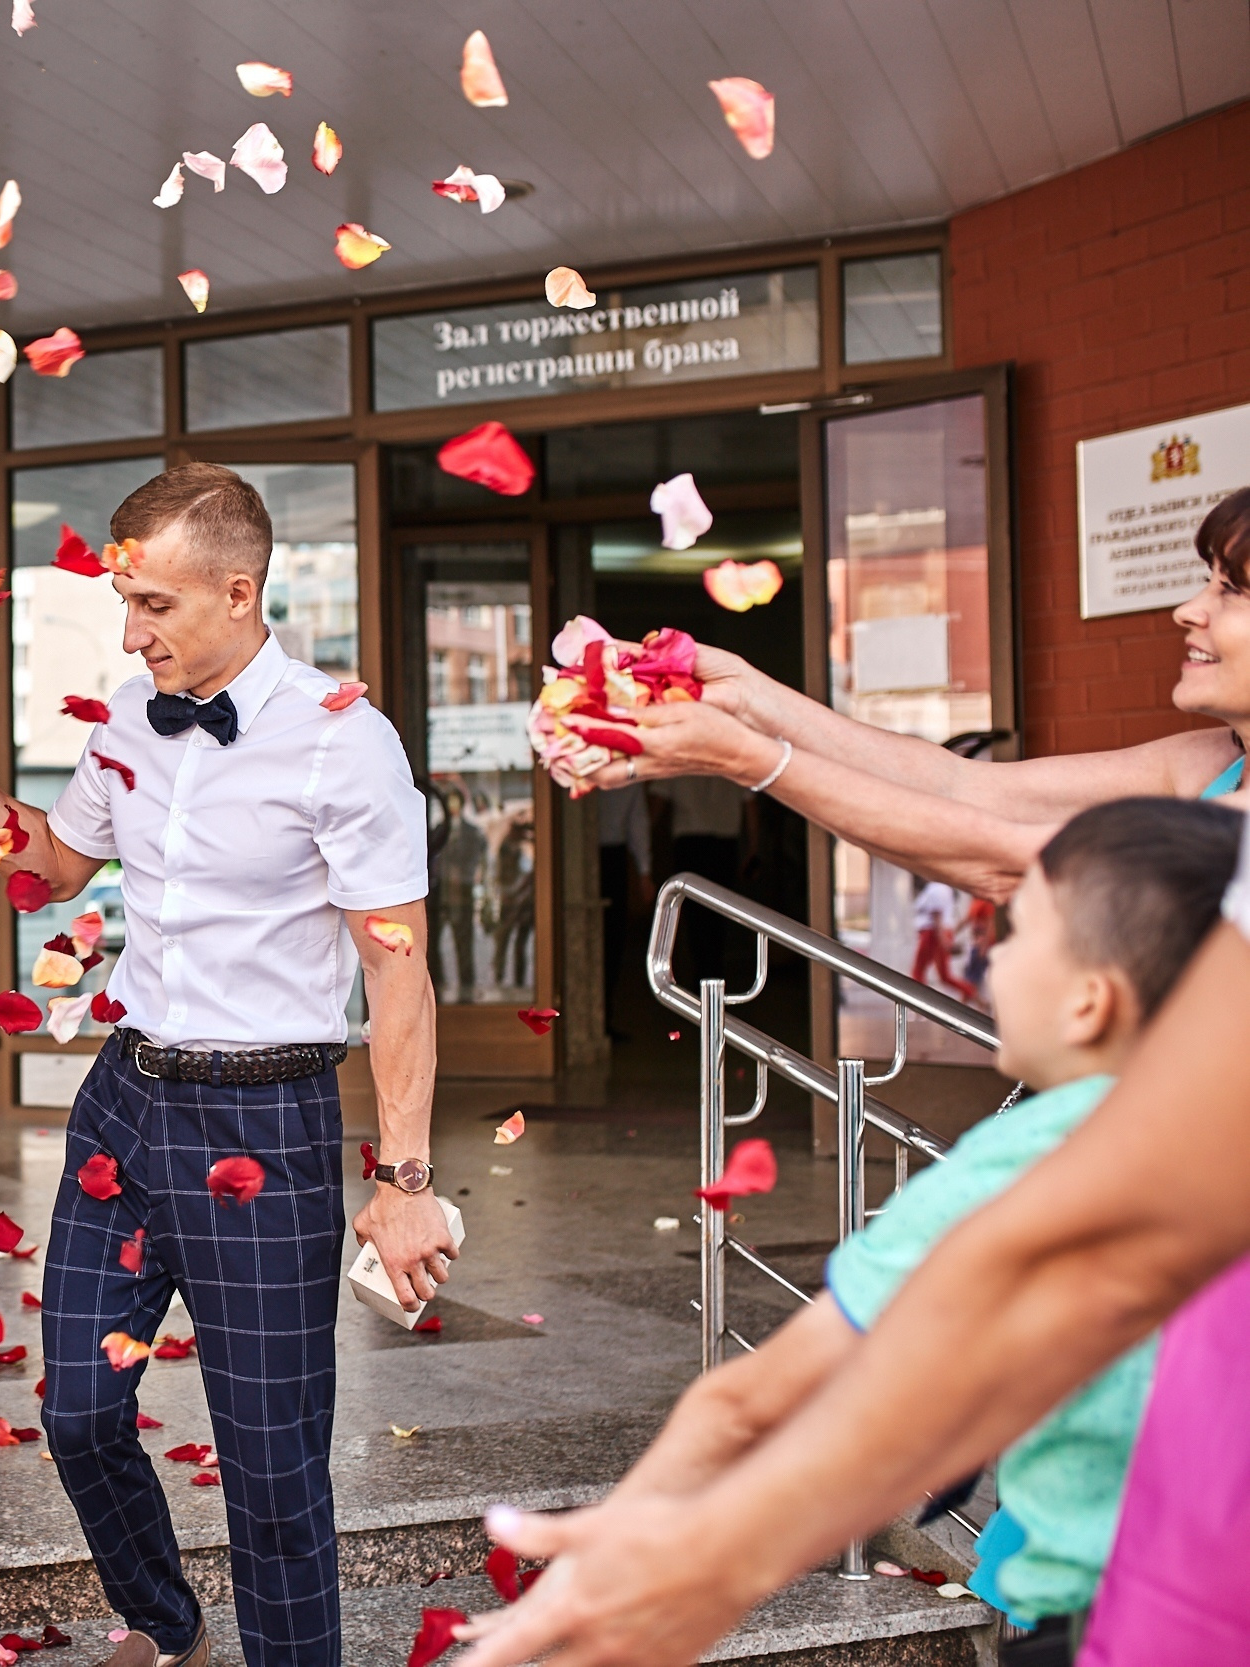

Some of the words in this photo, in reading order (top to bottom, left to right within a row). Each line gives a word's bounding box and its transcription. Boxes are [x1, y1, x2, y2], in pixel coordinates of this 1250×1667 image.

[433, 321, 489, 351] Зал
[497, 288, 740, 346] торжественной
[436, 348, 635, 398] регистрации
[642, 336, 740, 375] брака
